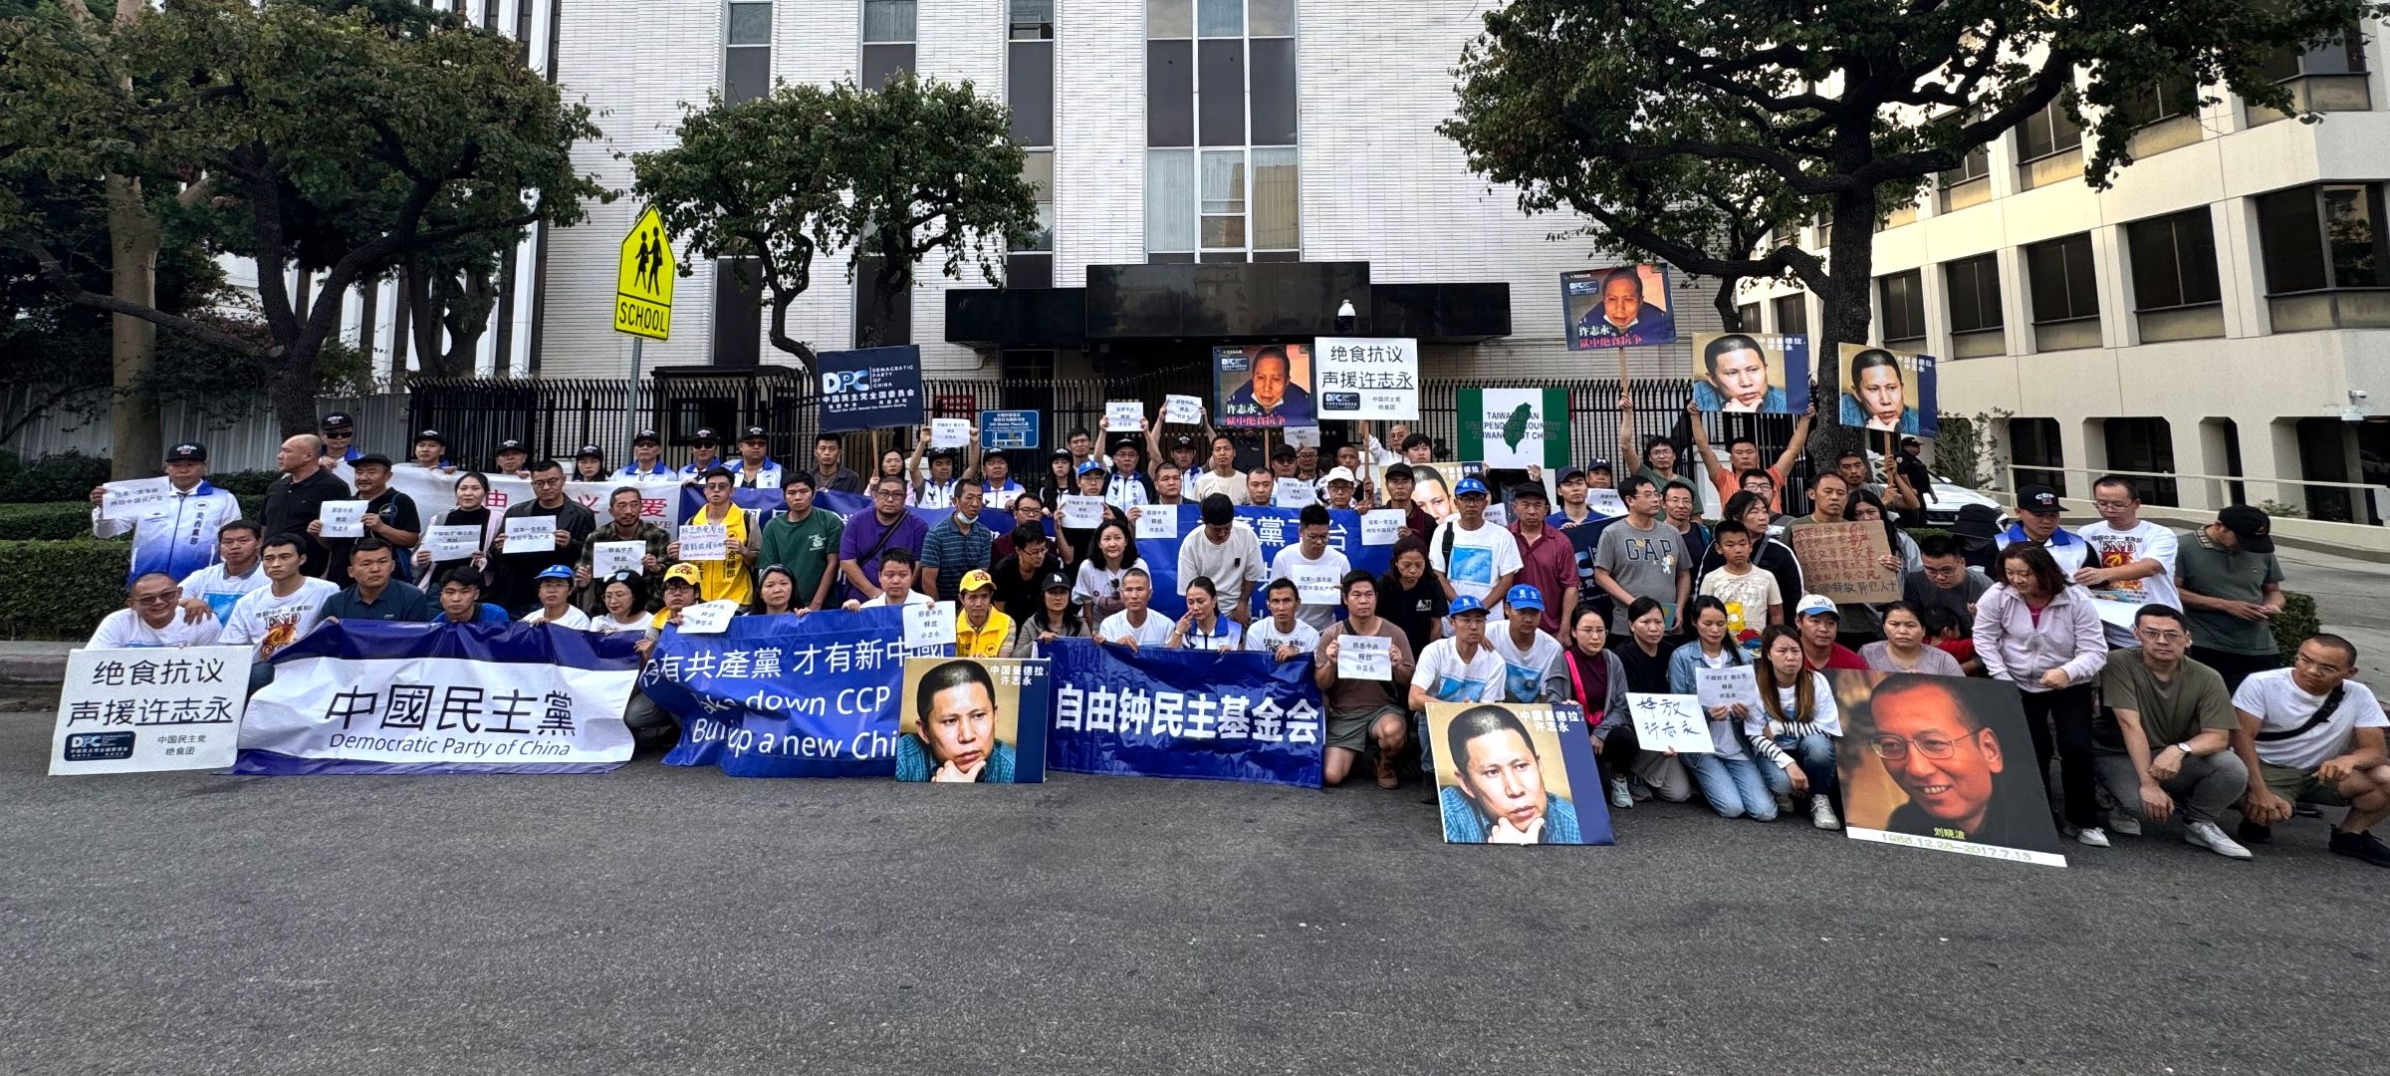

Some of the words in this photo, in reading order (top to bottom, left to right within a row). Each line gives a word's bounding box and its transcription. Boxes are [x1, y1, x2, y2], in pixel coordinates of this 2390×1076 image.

[619, 301, 666, 333] SCHOOL
[1330, 345, 1404, 363] 绝食抗议
[822, 369, 870, 394] DPC
[1321, 370, 1414, 389] 声援许志永
[822, 388, 915, 403] 中国民主党全国委员会
[1227, 403, 1258, 415] 许志永
[1487, 412, 1512, 420] TAIWA
[485, 489, 508, 508] 由
[1625, 538, 1672, 561] GAP
[2099, 540, 2136, 553] END
[264, 612, 301, 630] END
[92, 658, 224, 686] 绝食抗议
[1001, 675, 1032, 686] 许志永
[746, 689, 825, 716] down
[837, 685, 890, 715] CCP
[67, 695, 233, 728] 声援许志永
[325, 684, 576, 737] 中國民主黨
[1055, 683, 1319, 744] 自由钟民主基金会
[1534, 721, 1569, 733] 许志永
[71, 735, 102, 748] DPC
[157, 735, 206, 744] 中国民主党
[329, 733, 439, 754] Democratic
[442, 737, 493, 759] Party
[495, 739, 517, 756] of
[518, 740, 571, 756] China
[759, 731, 773, 753] a
[783, 735, 843, 759] new
[852, 729, 897, 759] Chi
[165, 747, 195, 756] 绝食团
[1933, 827, 1966, 841] 刘晓波
